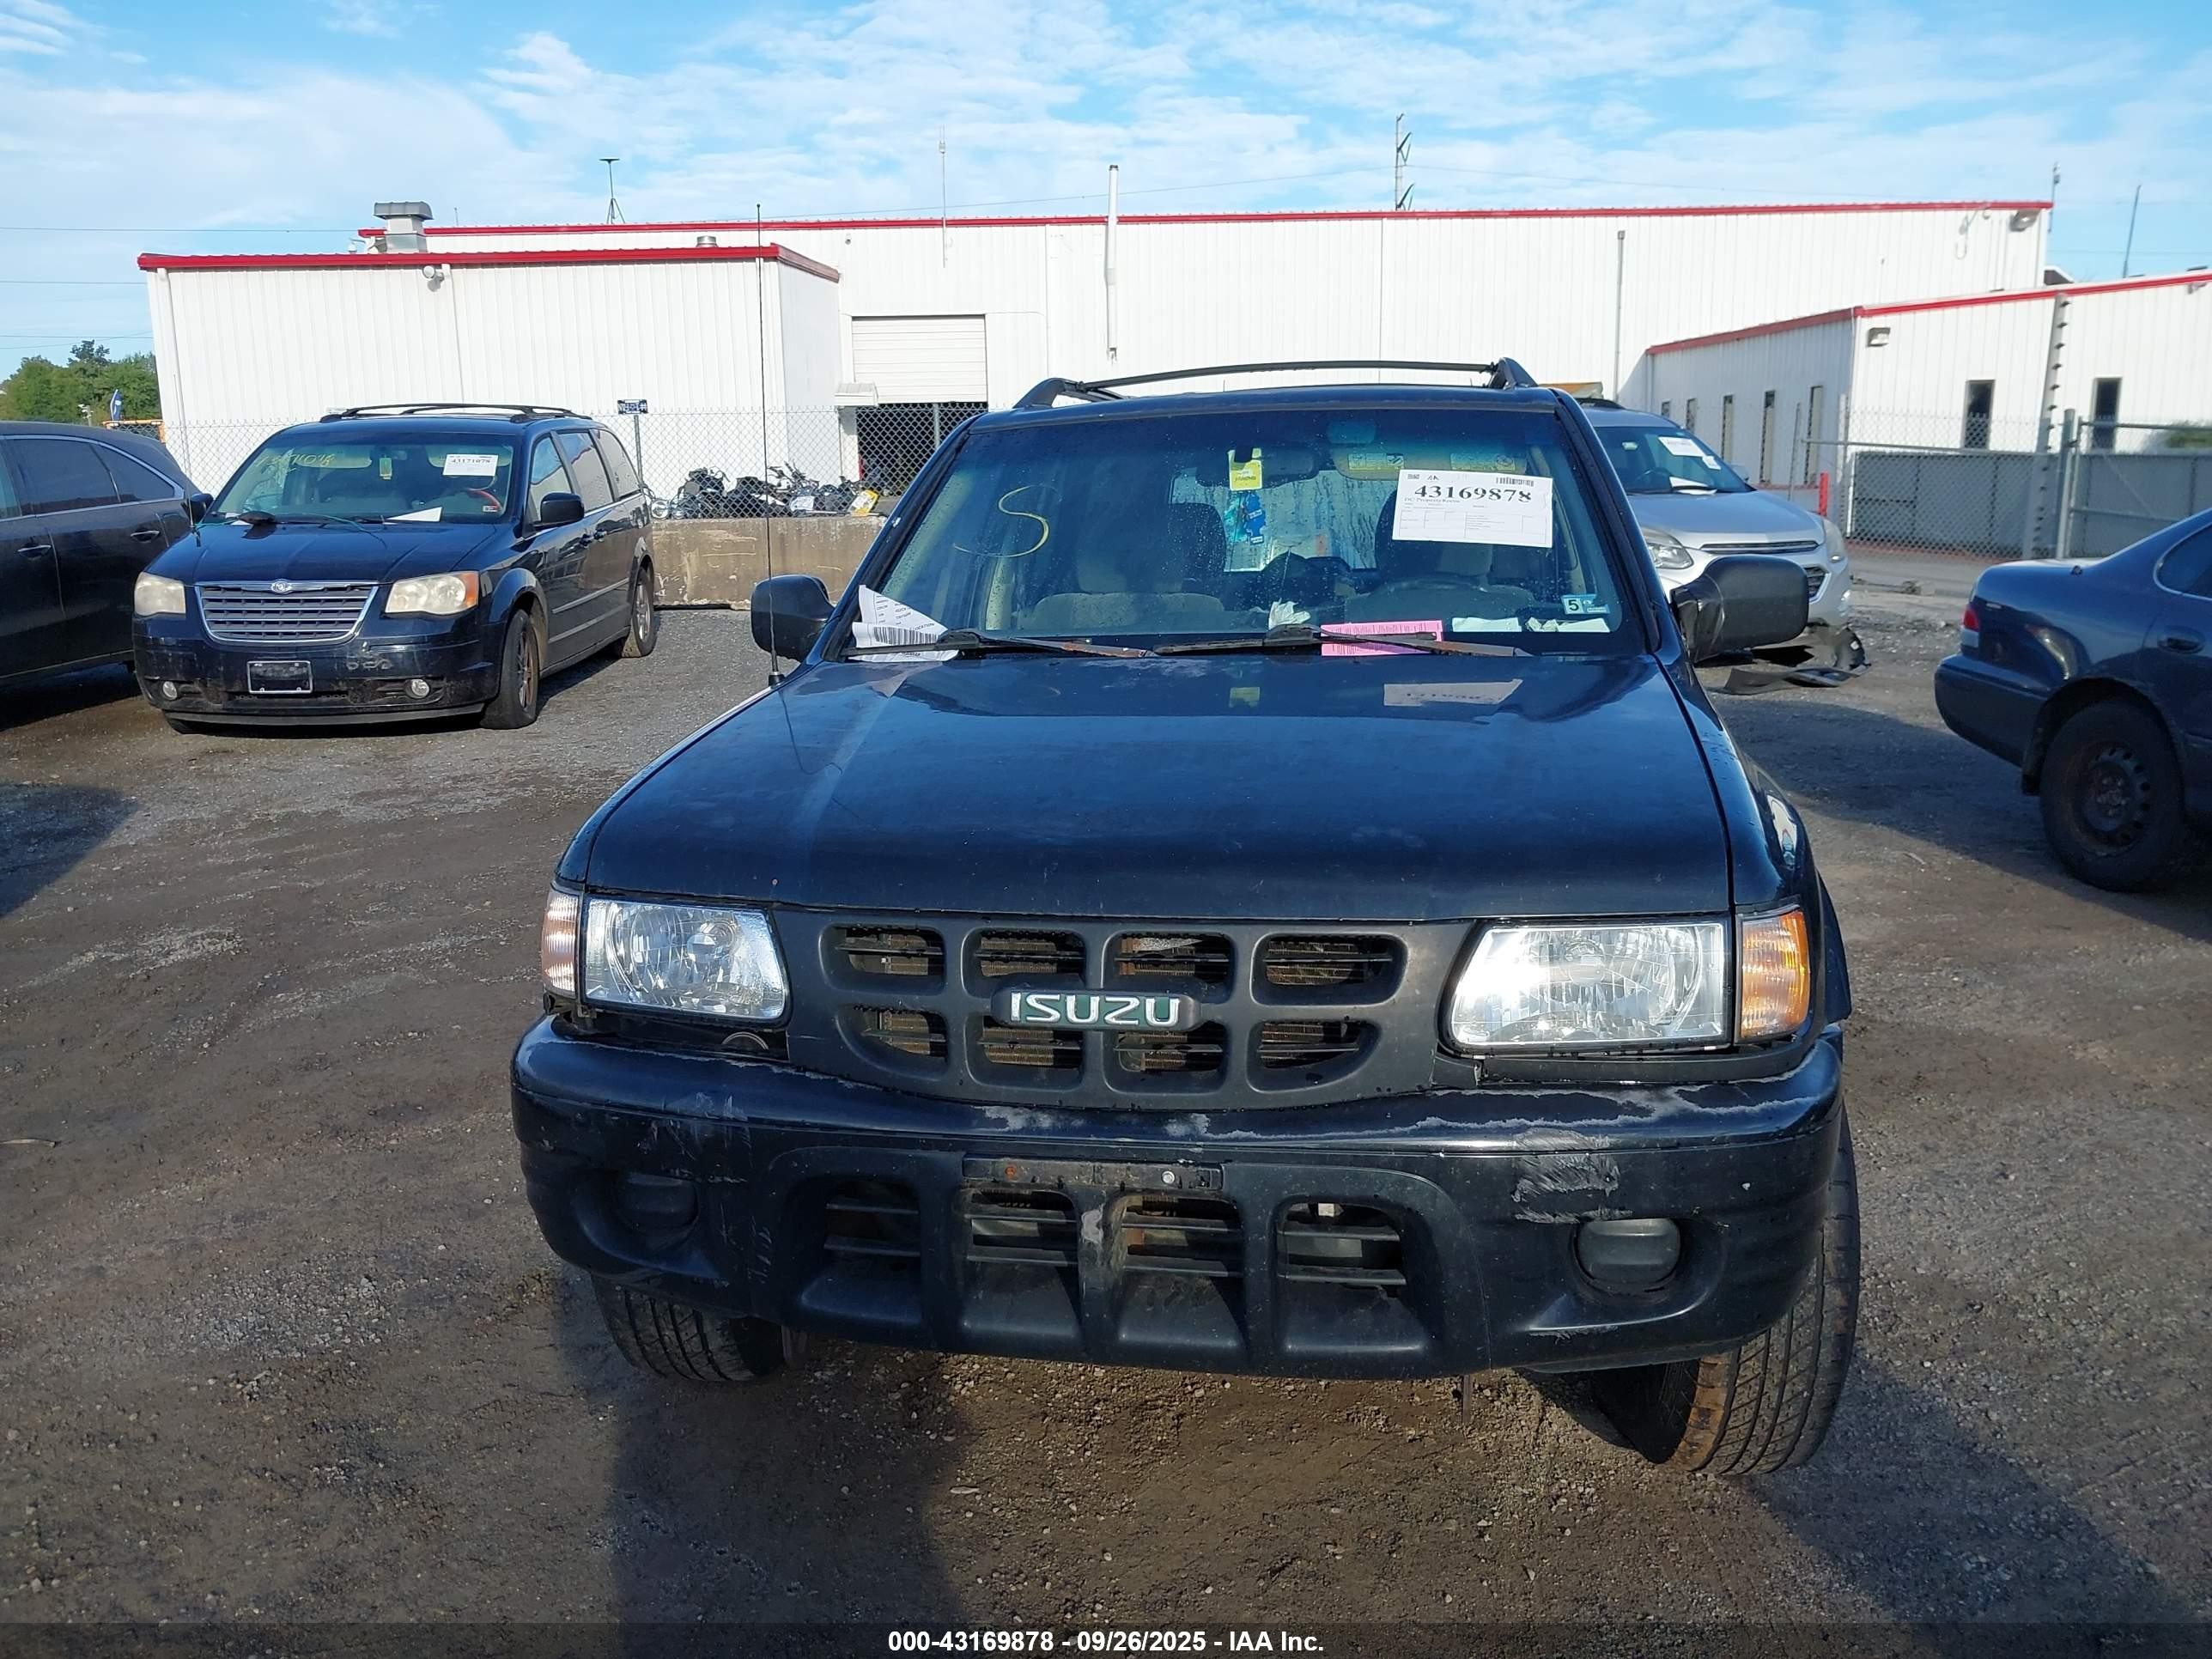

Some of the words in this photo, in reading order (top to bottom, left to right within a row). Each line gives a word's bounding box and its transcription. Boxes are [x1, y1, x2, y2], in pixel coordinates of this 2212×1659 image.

[1414, 484, 1532, 502] 43169878
[1568, 599, 1580, 611] 5
[1010, 992, 1181, 1028] ISUZU
